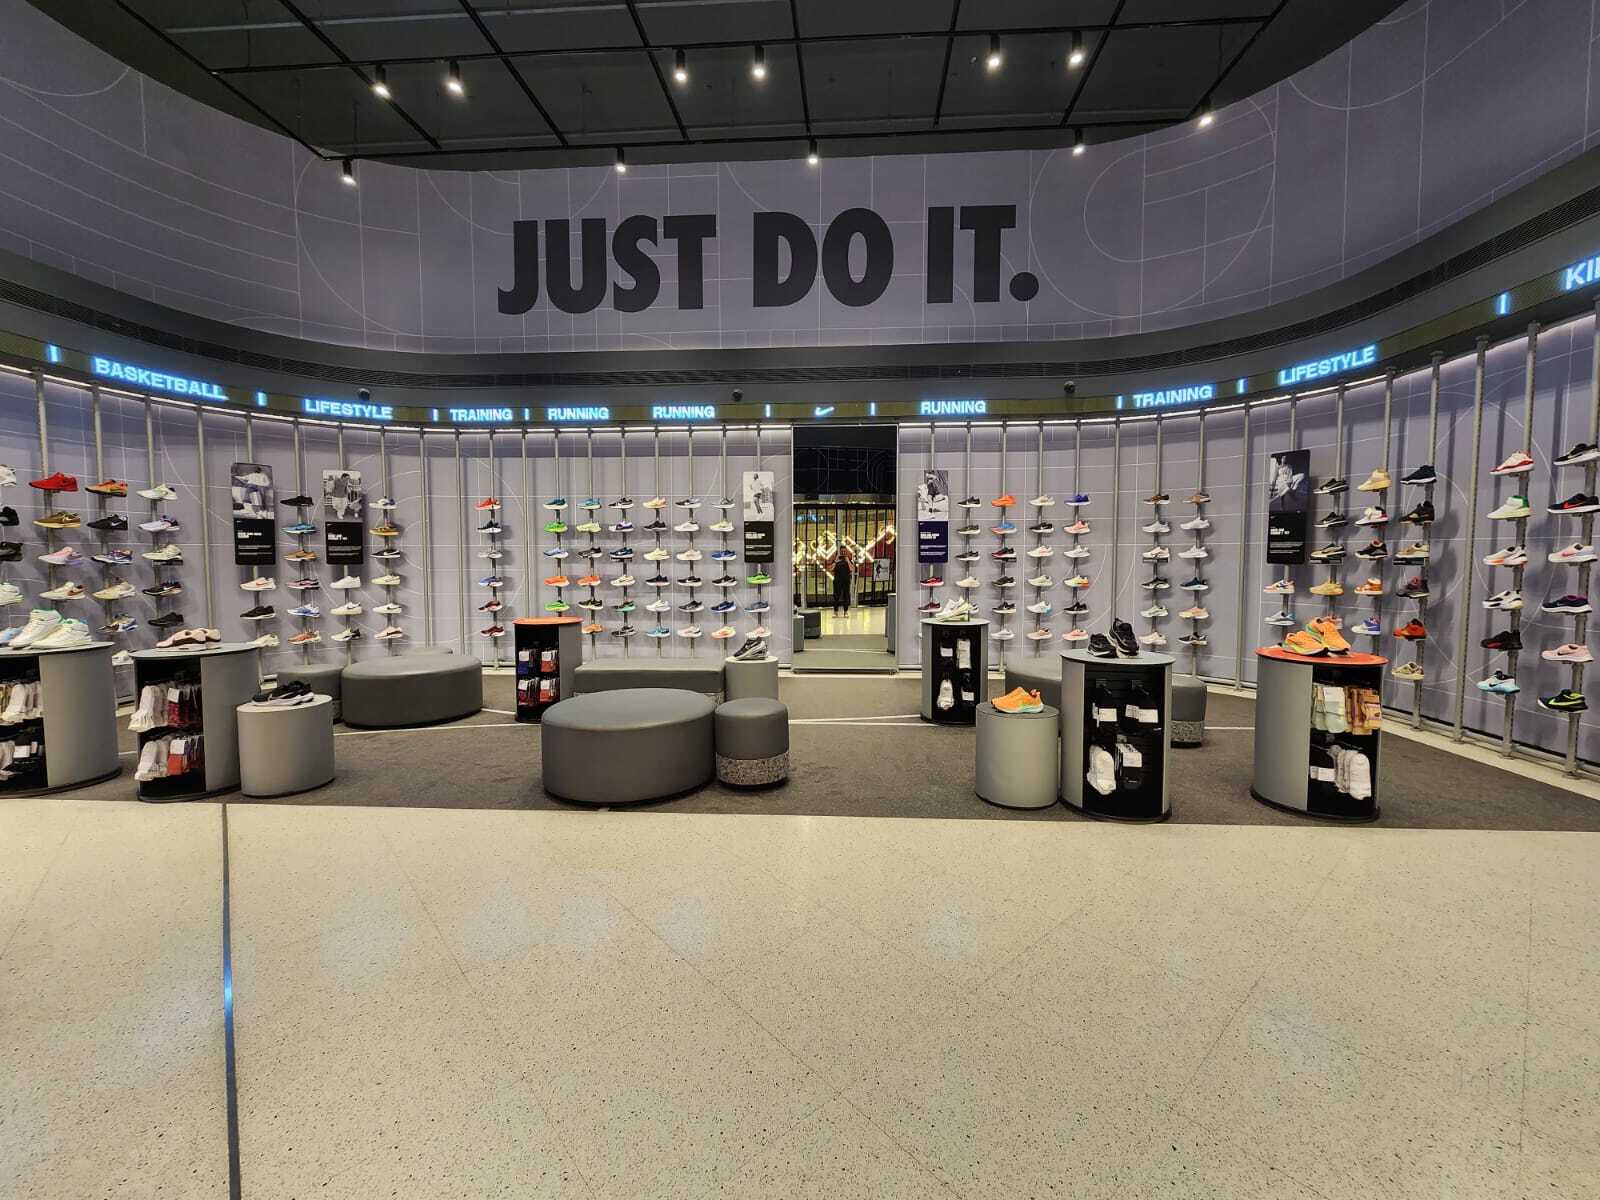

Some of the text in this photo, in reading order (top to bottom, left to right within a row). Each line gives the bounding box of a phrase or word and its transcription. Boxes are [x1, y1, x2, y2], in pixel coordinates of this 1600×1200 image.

[498, 205, 1039, 315] JUST DO IT.
[1565, 257, 1600, 290] KI
[1279, 345, 1377, 385] LIFESTYLE
[94, 356, 228, 401] BASKETBALL
[920, 399, 987, 416] RUNNING
[1132, 384, 1213, 408] TRAINING
[304, 398, 393, 420] LIFESTYLE
[449, 407, 513, 422] TRAINING
[547, 406, 610, 421] RUNNING
[652, 405, 715, 420] RUNNING
